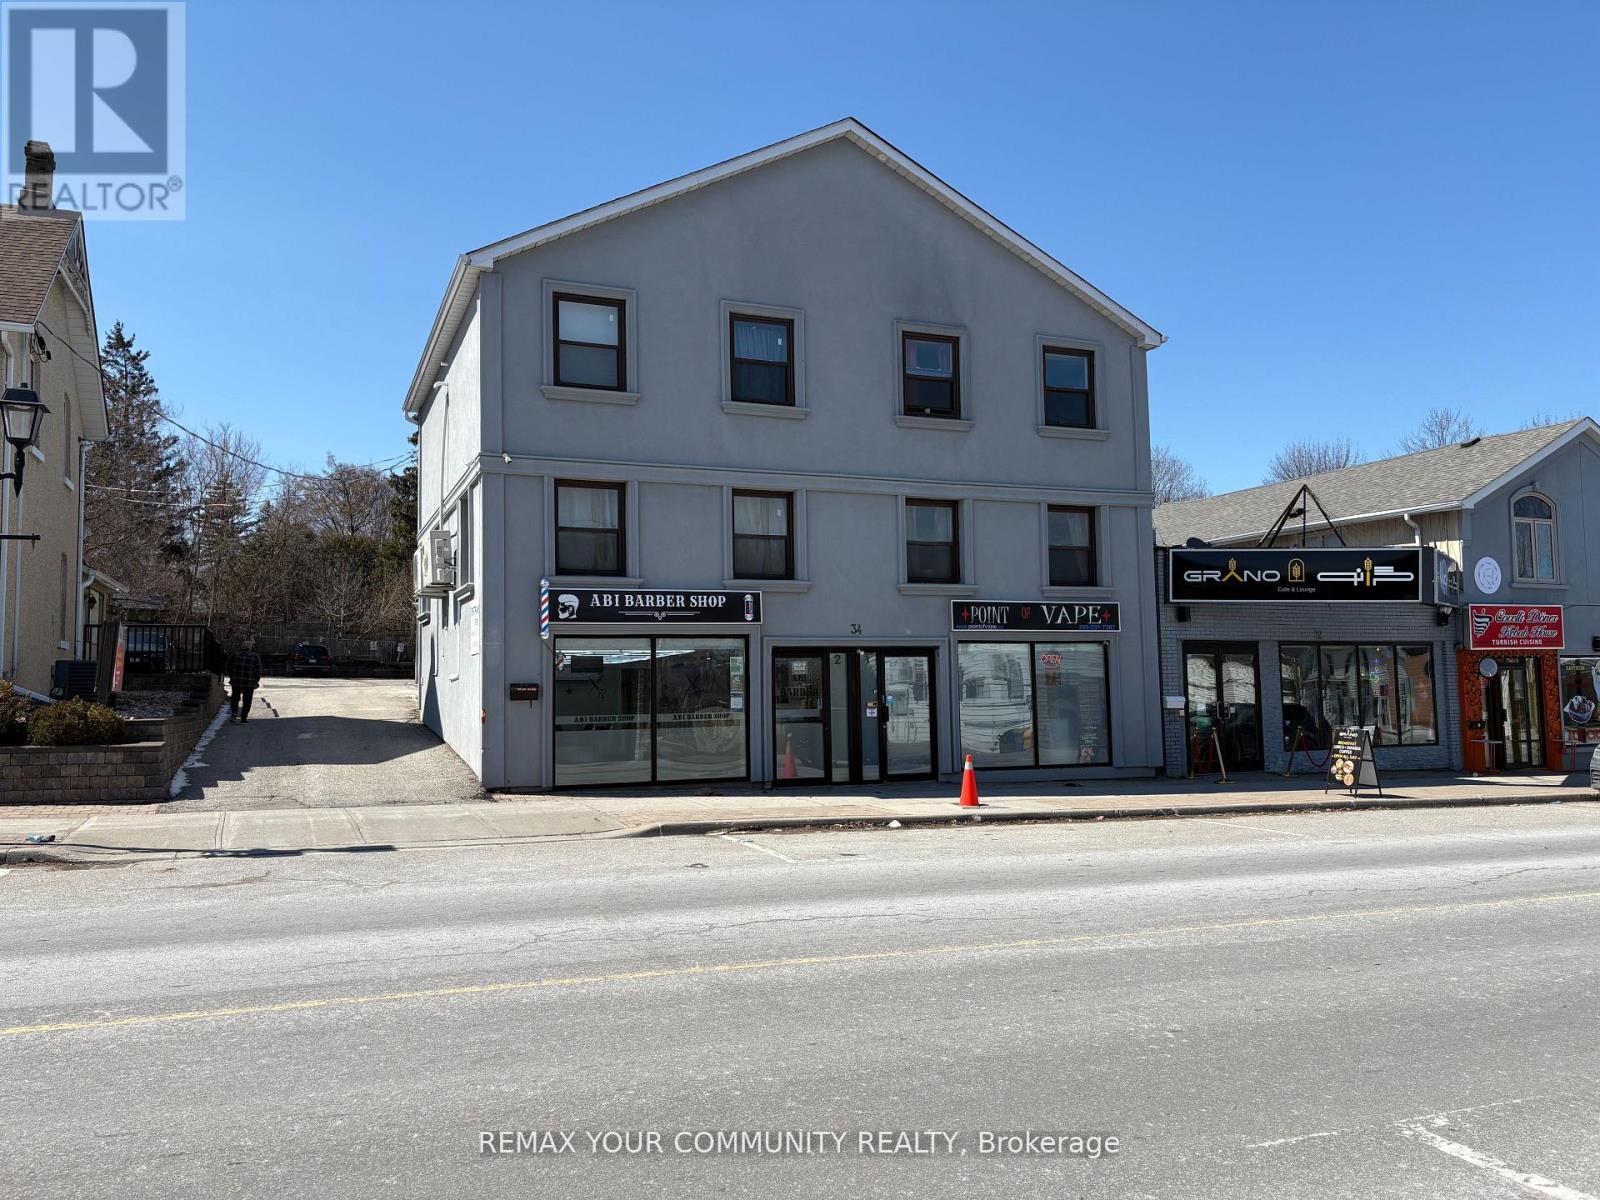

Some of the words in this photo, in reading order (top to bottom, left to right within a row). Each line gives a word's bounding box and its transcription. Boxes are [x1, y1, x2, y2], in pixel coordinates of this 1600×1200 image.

[590, 593, 620, 607] ABI
[624, 594, 686, 607] BARBER
[689, 595, 727, 608] SHOP
[970, 605, 1010, 624] POINT
[1020, 607, 1032, 619] OF
[1040, 605, 1102, 624] VAPE
[850, 623, 863, 635] 34
[1498, 625, 1530, 638] Kebab
[1529, 625, 1559, 638] House
[1040, 654, 1063, 665] OPEN
